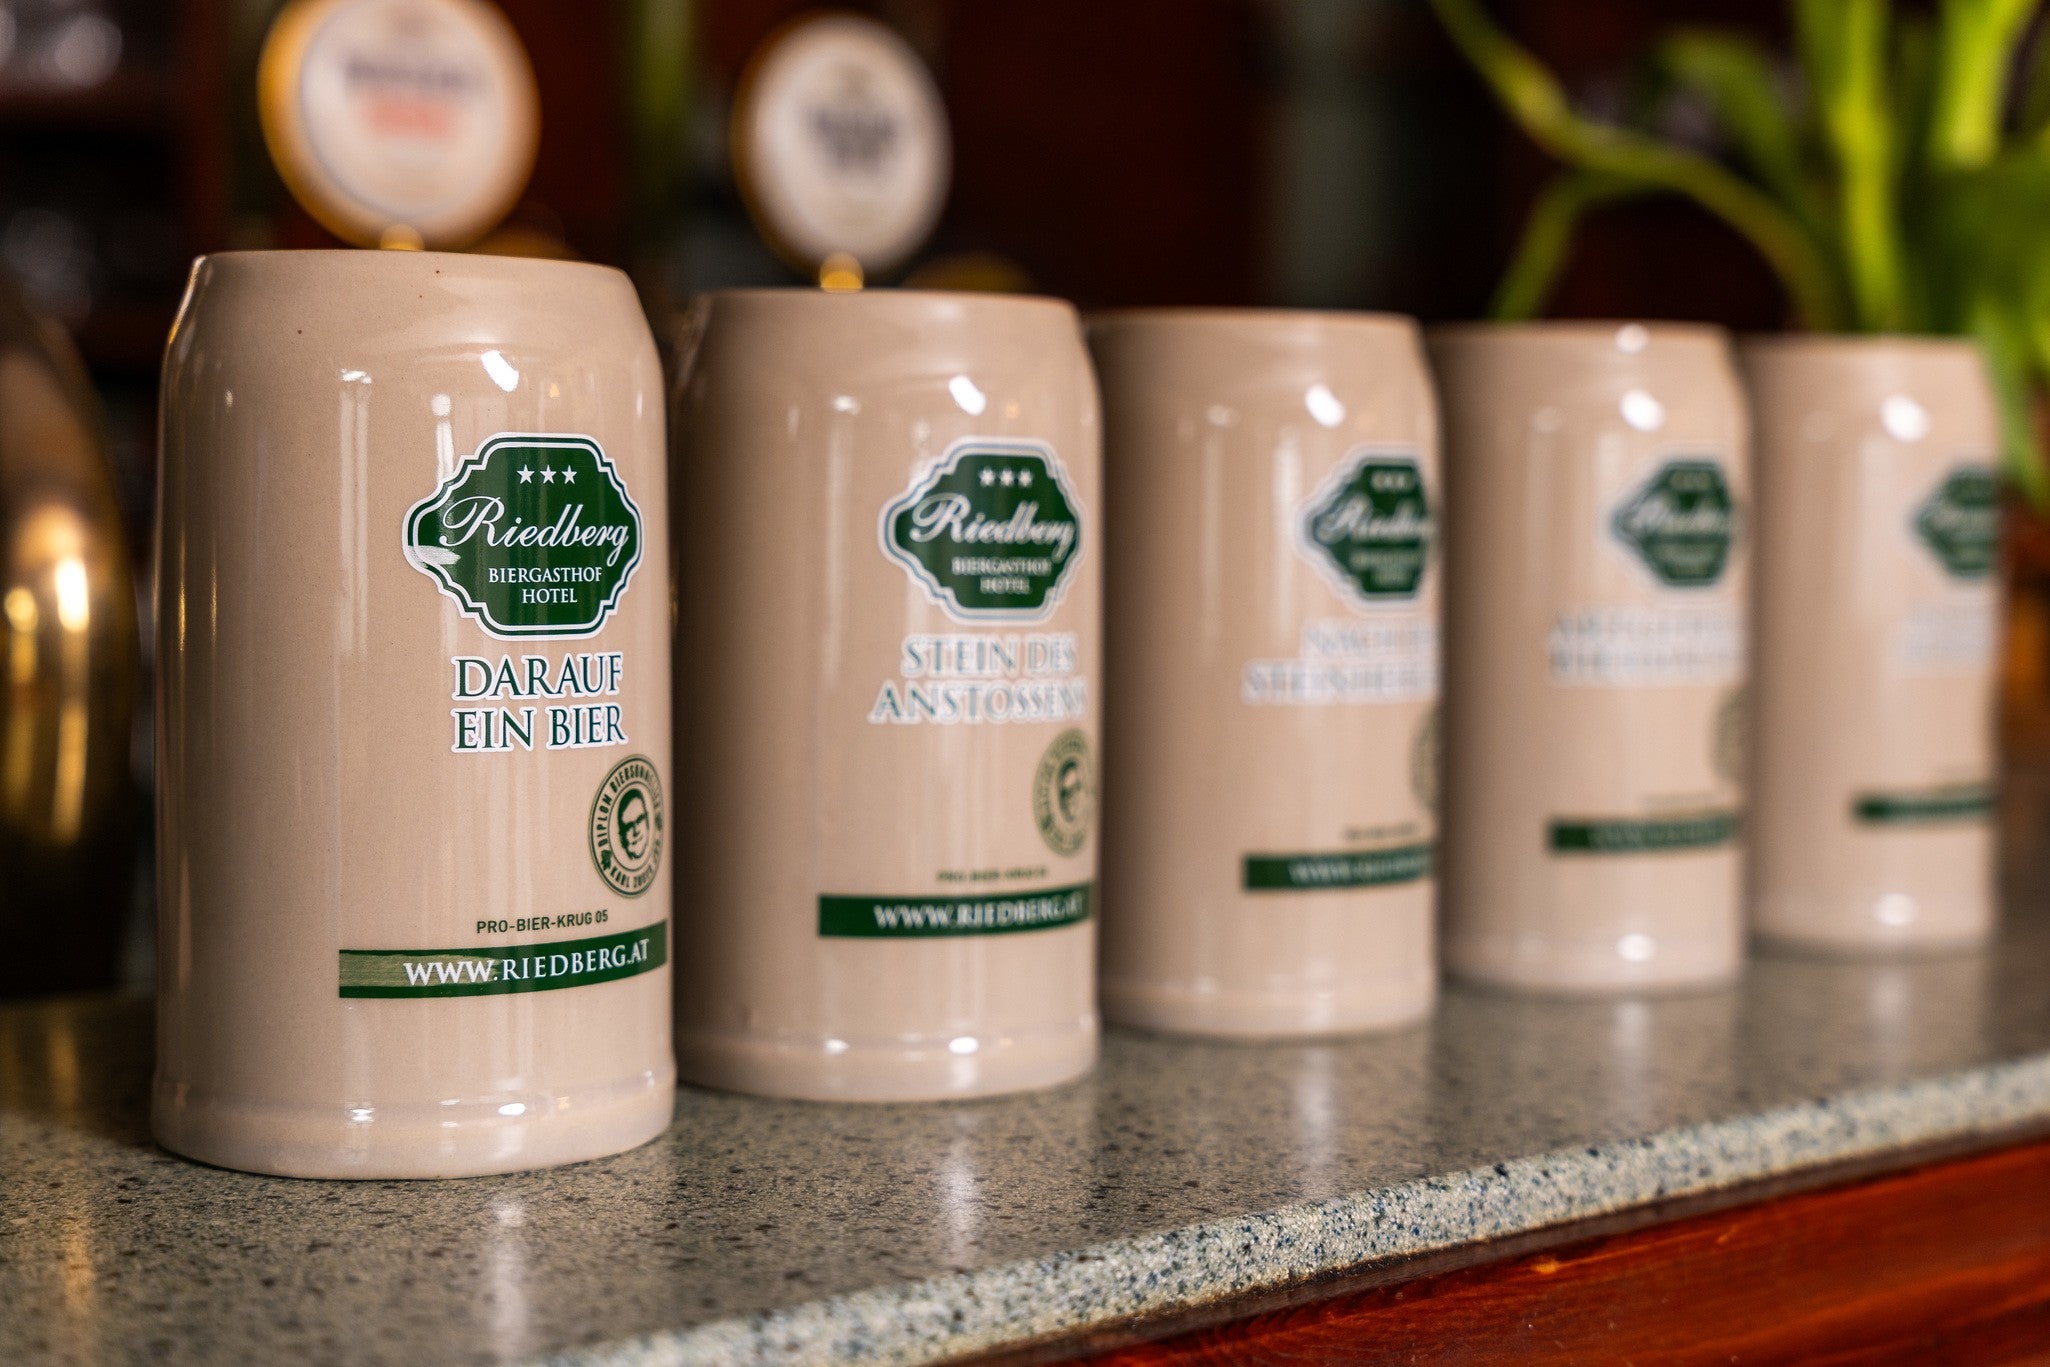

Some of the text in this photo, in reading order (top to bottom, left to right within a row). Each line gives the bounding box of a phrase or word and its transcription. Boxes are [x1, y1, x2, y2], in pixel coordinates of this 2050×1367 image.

[438, 495, 630, 567] Riedberg
[909, 491, 1075, 564] Riedberg
[488, 566, 603, 584] BIERGASTHOF
[521, 587, 578, 604] HOTEL
[453, 652, 622, 699] DARAUF
[902, 632, 1077, 677] STEIN DES
[453, 704, 627, 751] EIN BIER
[475, 909, 609, 935] PRO-BIER-KRUG 05
[402, 937, 651, 987] WWW.RIEDBERG.AT
